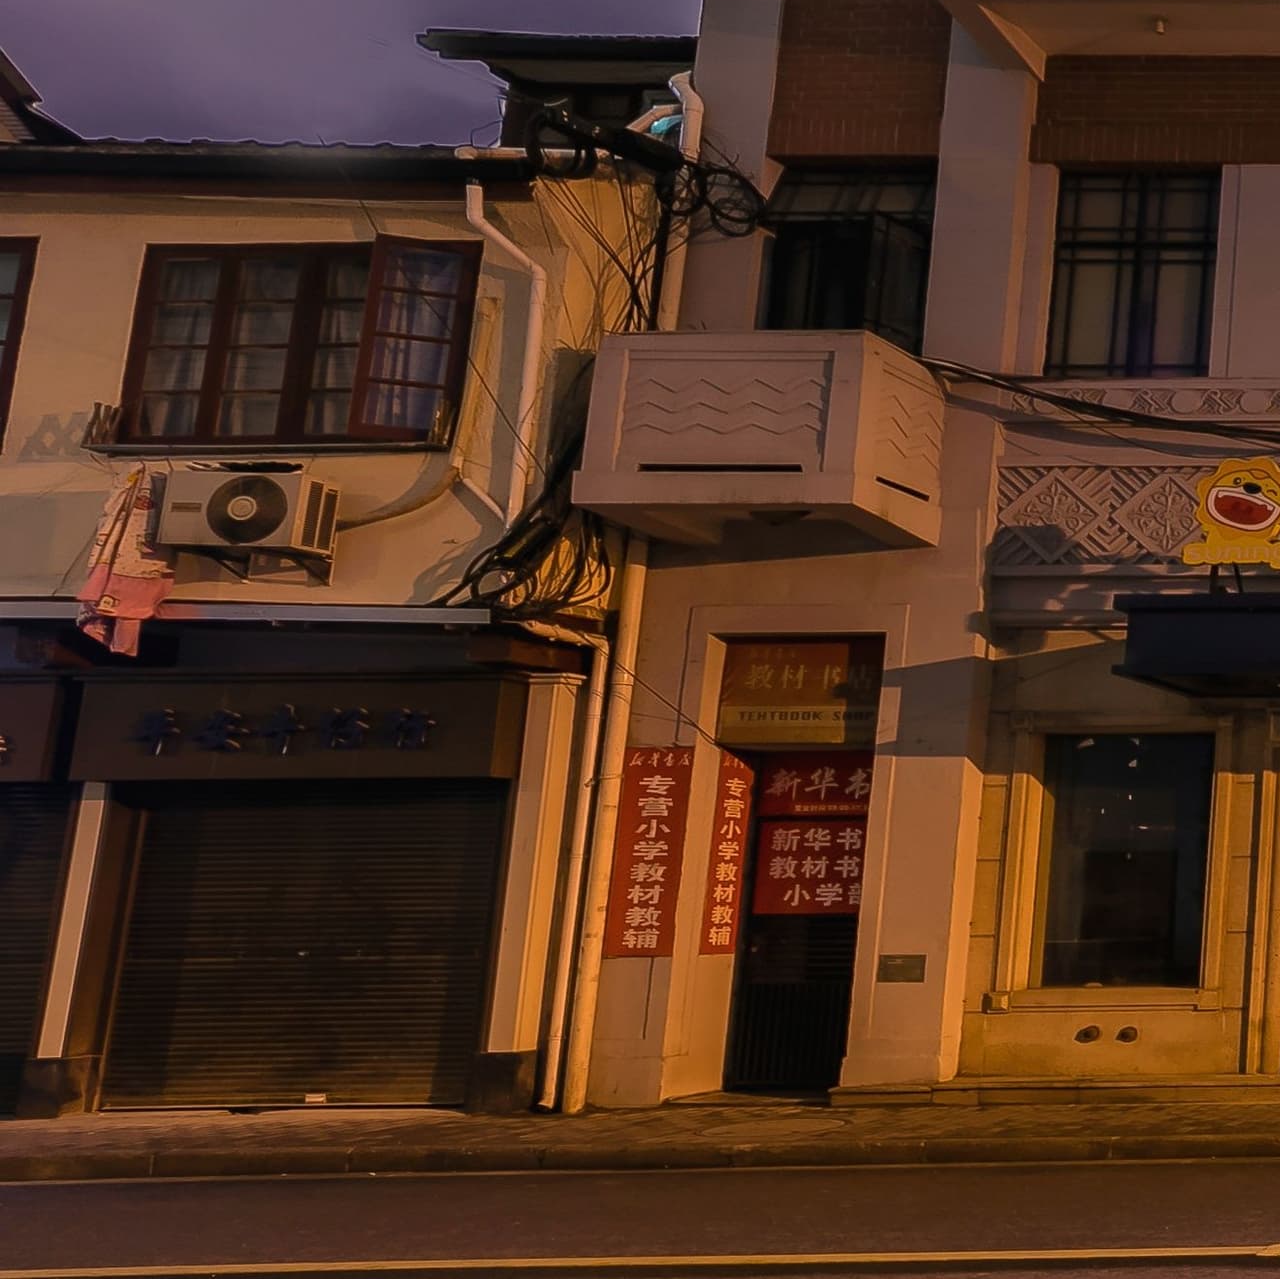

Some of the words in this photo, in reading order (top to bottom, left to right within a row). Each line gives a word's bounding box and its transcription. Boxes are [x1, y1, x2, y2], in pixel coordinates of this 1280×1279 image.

[622, 775, 676, 949] 专营小学教材教辅
[708, 777, 748, 947] 专营小学教材教辅
